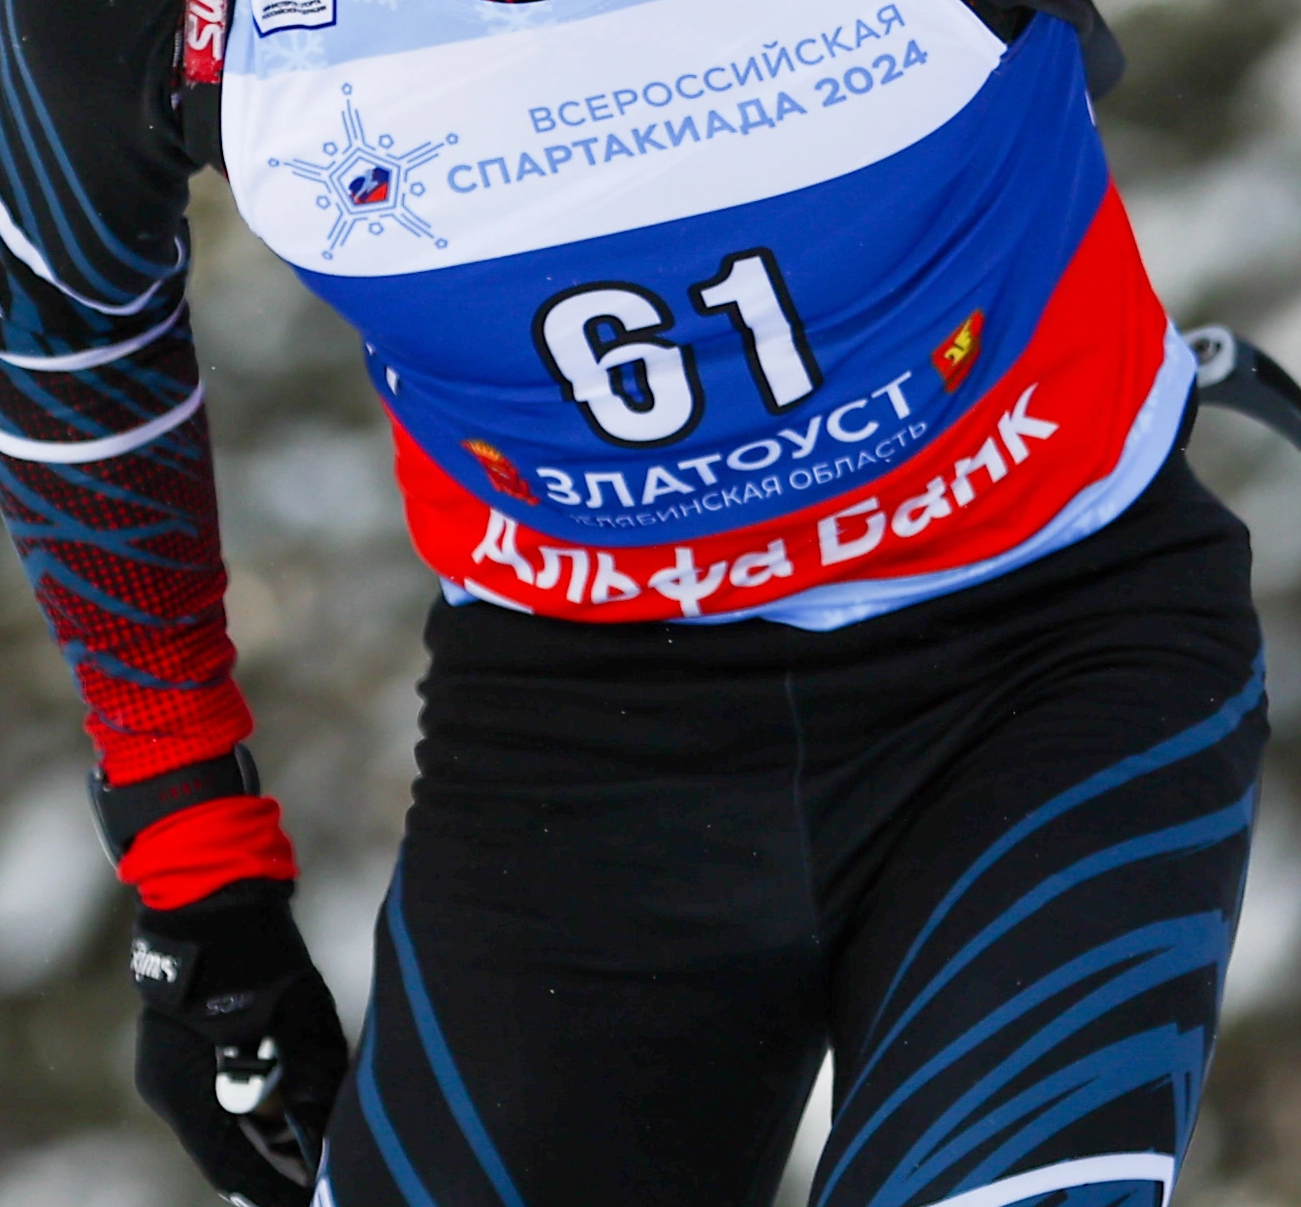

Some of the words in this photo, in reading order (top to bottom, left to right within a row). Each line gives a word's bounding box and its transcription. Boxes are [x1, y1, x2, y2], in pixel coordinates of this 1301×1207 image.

[446, 91, 808, 194] СПАРТАКИАДА
[813, 39, 929, 107] 2024
[528, 3, 906, 134] ВСЕРОССИЙСКАЯ
[533, 246, 825, 450] 61
[535, 371, 912, 509] ЗЛАТОУСТ
[788, 421, 928, 490] ОБЛАСТЬ
